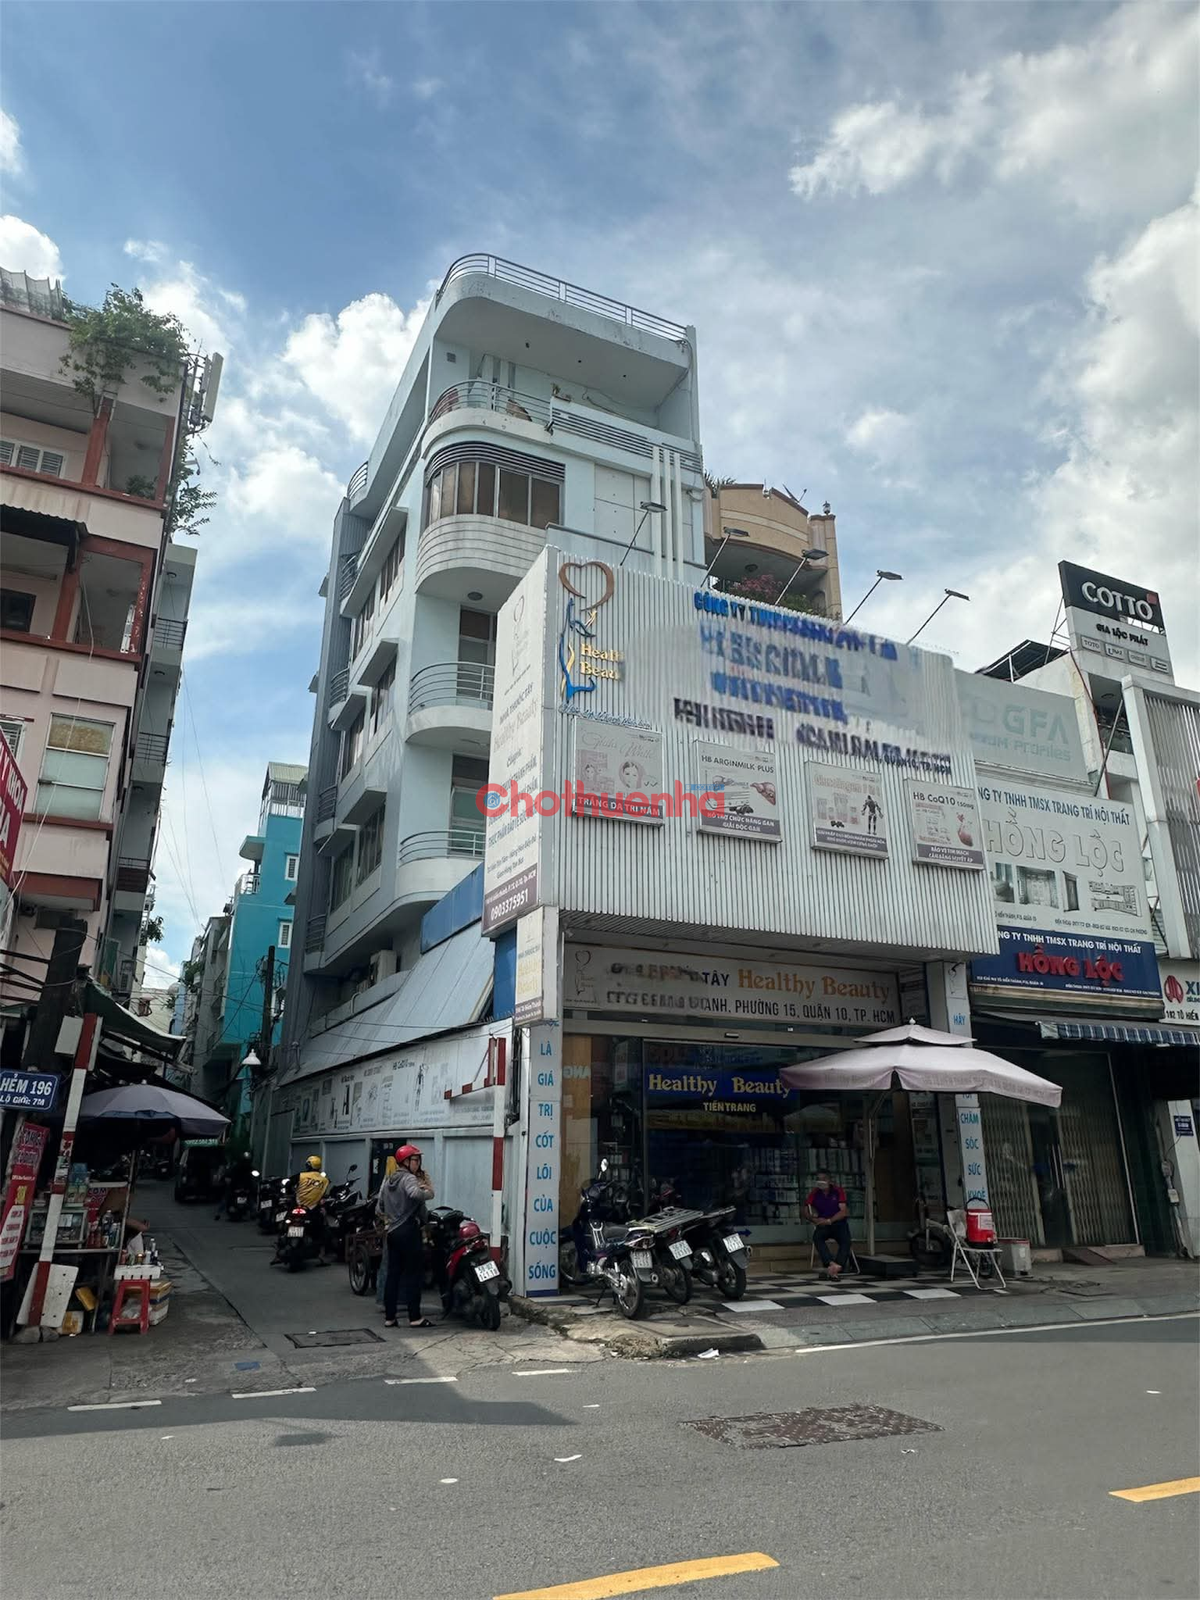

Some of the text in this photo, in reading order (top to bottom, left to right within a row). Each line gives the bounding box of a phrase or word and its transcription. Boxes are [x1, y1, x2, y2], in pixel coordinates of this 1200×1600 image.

[1081, 581, 1153, 620] COTTO
[1096, 623, 1149, 646] GIA LỘC PHÁT
[757, 765, 774, 773] PLUS
[610, 801, 623, 811] DA
[913, 792, 925, 801] HB
[928, 793, 956, 806] CoQ10
[992, 790, 1002, 803] TY
[1004, 791, 1027, 807] TNHH
[1029, 796, 1050, 812] TMSX
[1052, 801, 1079, 818] TRANG
[1080, 804, 1093, 819] TRÍ
[1095, 807, 1110, 826] NỘI
[1111, 808, 1130, 826] THẤT
[982, 807, 1124, 877] HỒNG LỘC
[491, 888, 529, 921] 0903375951
[1011, 932, 1021, 941] TY
[1022, 933, 1045, 944] TNHH
[1046, 936, 1067, 947] TMSX
[1067, 939, 1094, 949] TRANG
[1095, 941, 1107, 950] TRÍ
[1108, 943, 1122, 954] NỘI
[1123, 942, 1141, 954] THẤT
[1017, 944, 1125, 986] HỒNG LỘC
[702, 969, 730, 986] TÂY
[737, 968, 816, 999] Healthy
[821, 975, 890, 1005] Beauty
[735, 998, 779, 1016] PHƯỜNG
[802, 1001, 831, 1022] QUẬN
[873, 1009, 895, 1024] HCM
[540, 1041, 552, 1056] LÀ
[30, 1080, 52, 1096] 196
[538, 1070, 554, 1086] GIÁ
[649, 1074, 791, 1099] Healthy Beauty
[538, 1103, 553, 1121] TRỊ
[725, 1102, 757, 1112] TRANG
[535, 1130, 554, 1148] CỐT
[533, 1194, 553, 1212] CỦA
[529, 1228, 556, 1249] CUỘC
[528, 1260, 556, 1280] SỐNG
